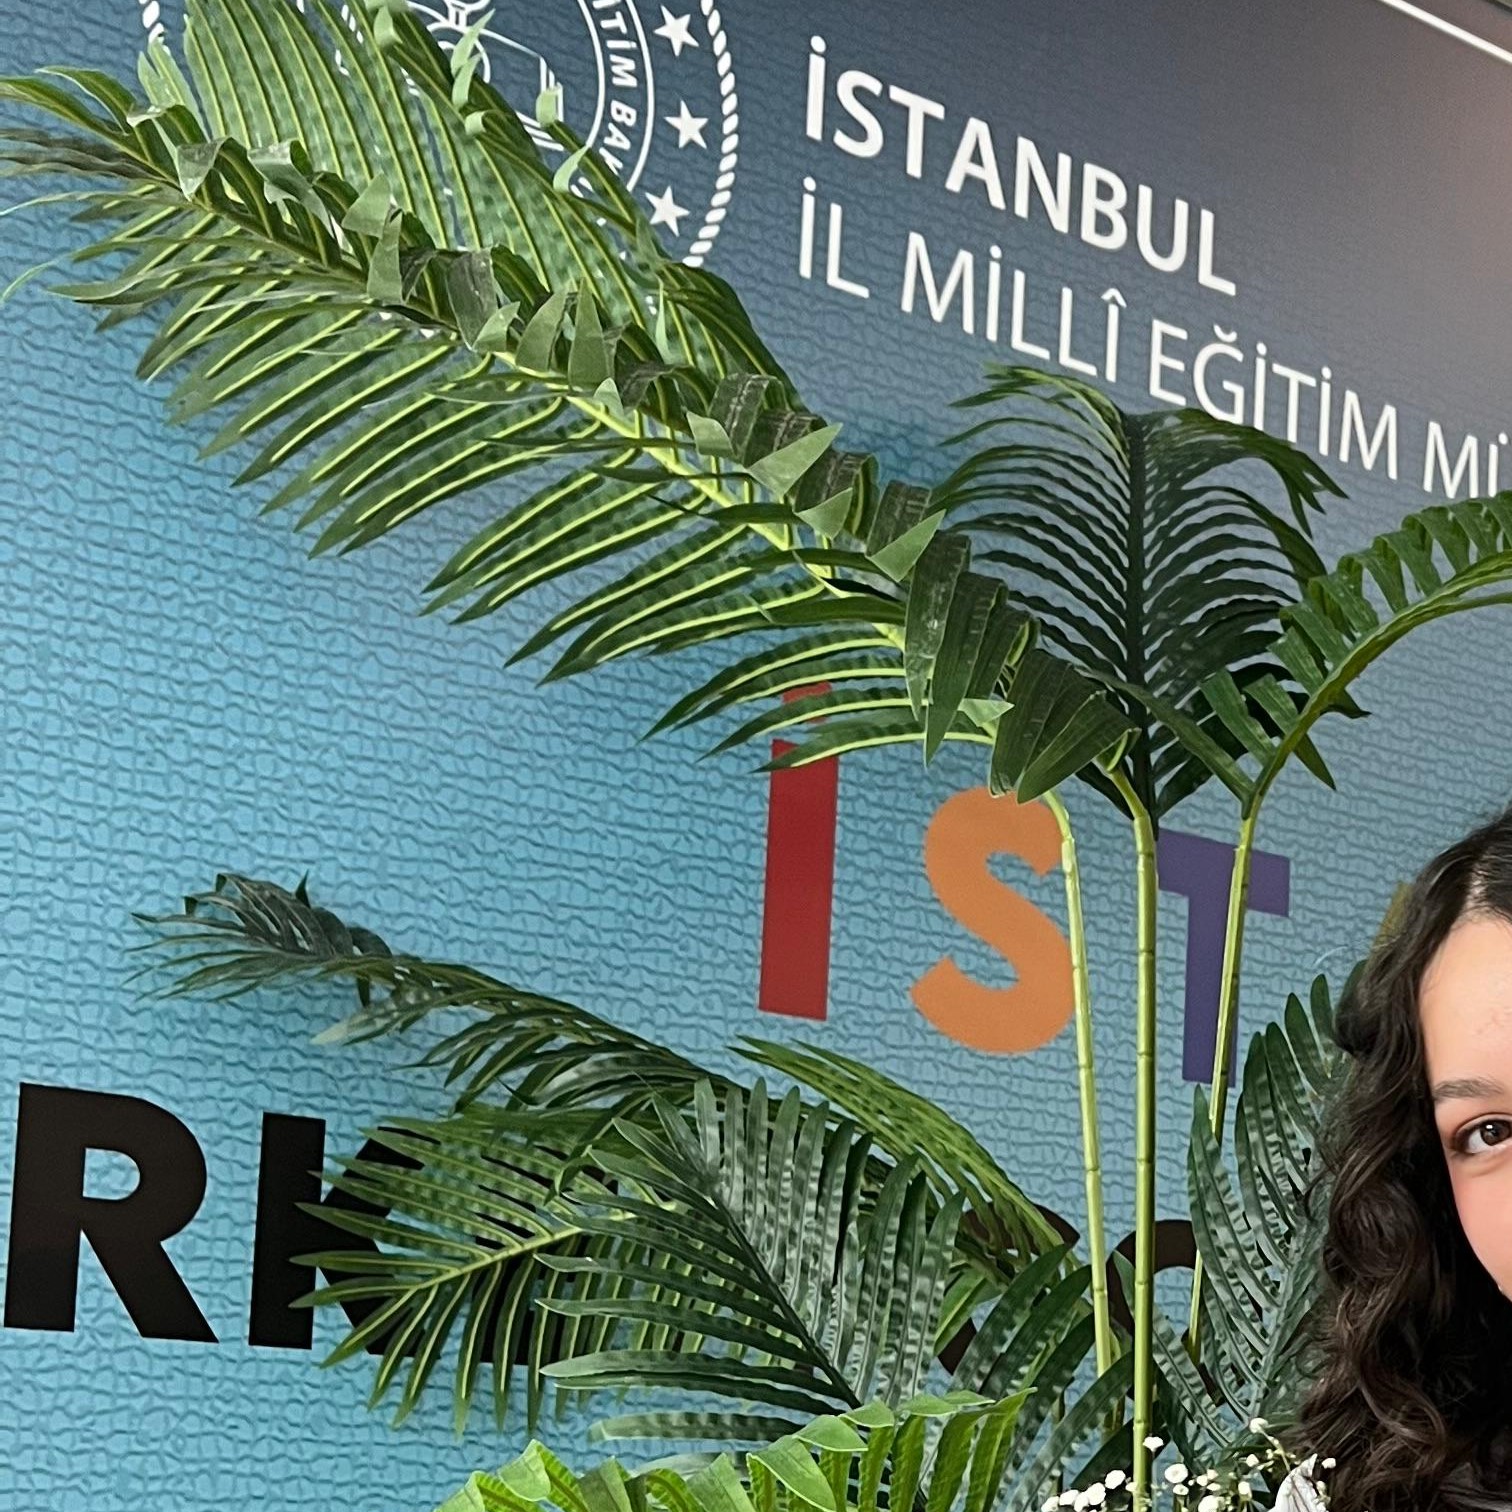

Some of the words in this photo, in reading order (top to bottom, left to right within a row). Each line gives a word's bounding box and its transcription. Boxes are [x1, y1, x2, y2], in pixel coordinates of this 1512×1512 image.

[805, 35, 1237, 297] İSTANBUL
[799, 176, 870, 299] İL
[899, 231, 1128, 384] MİLLÎ
[1148, 319, 1400, 481] EĞİTİM
